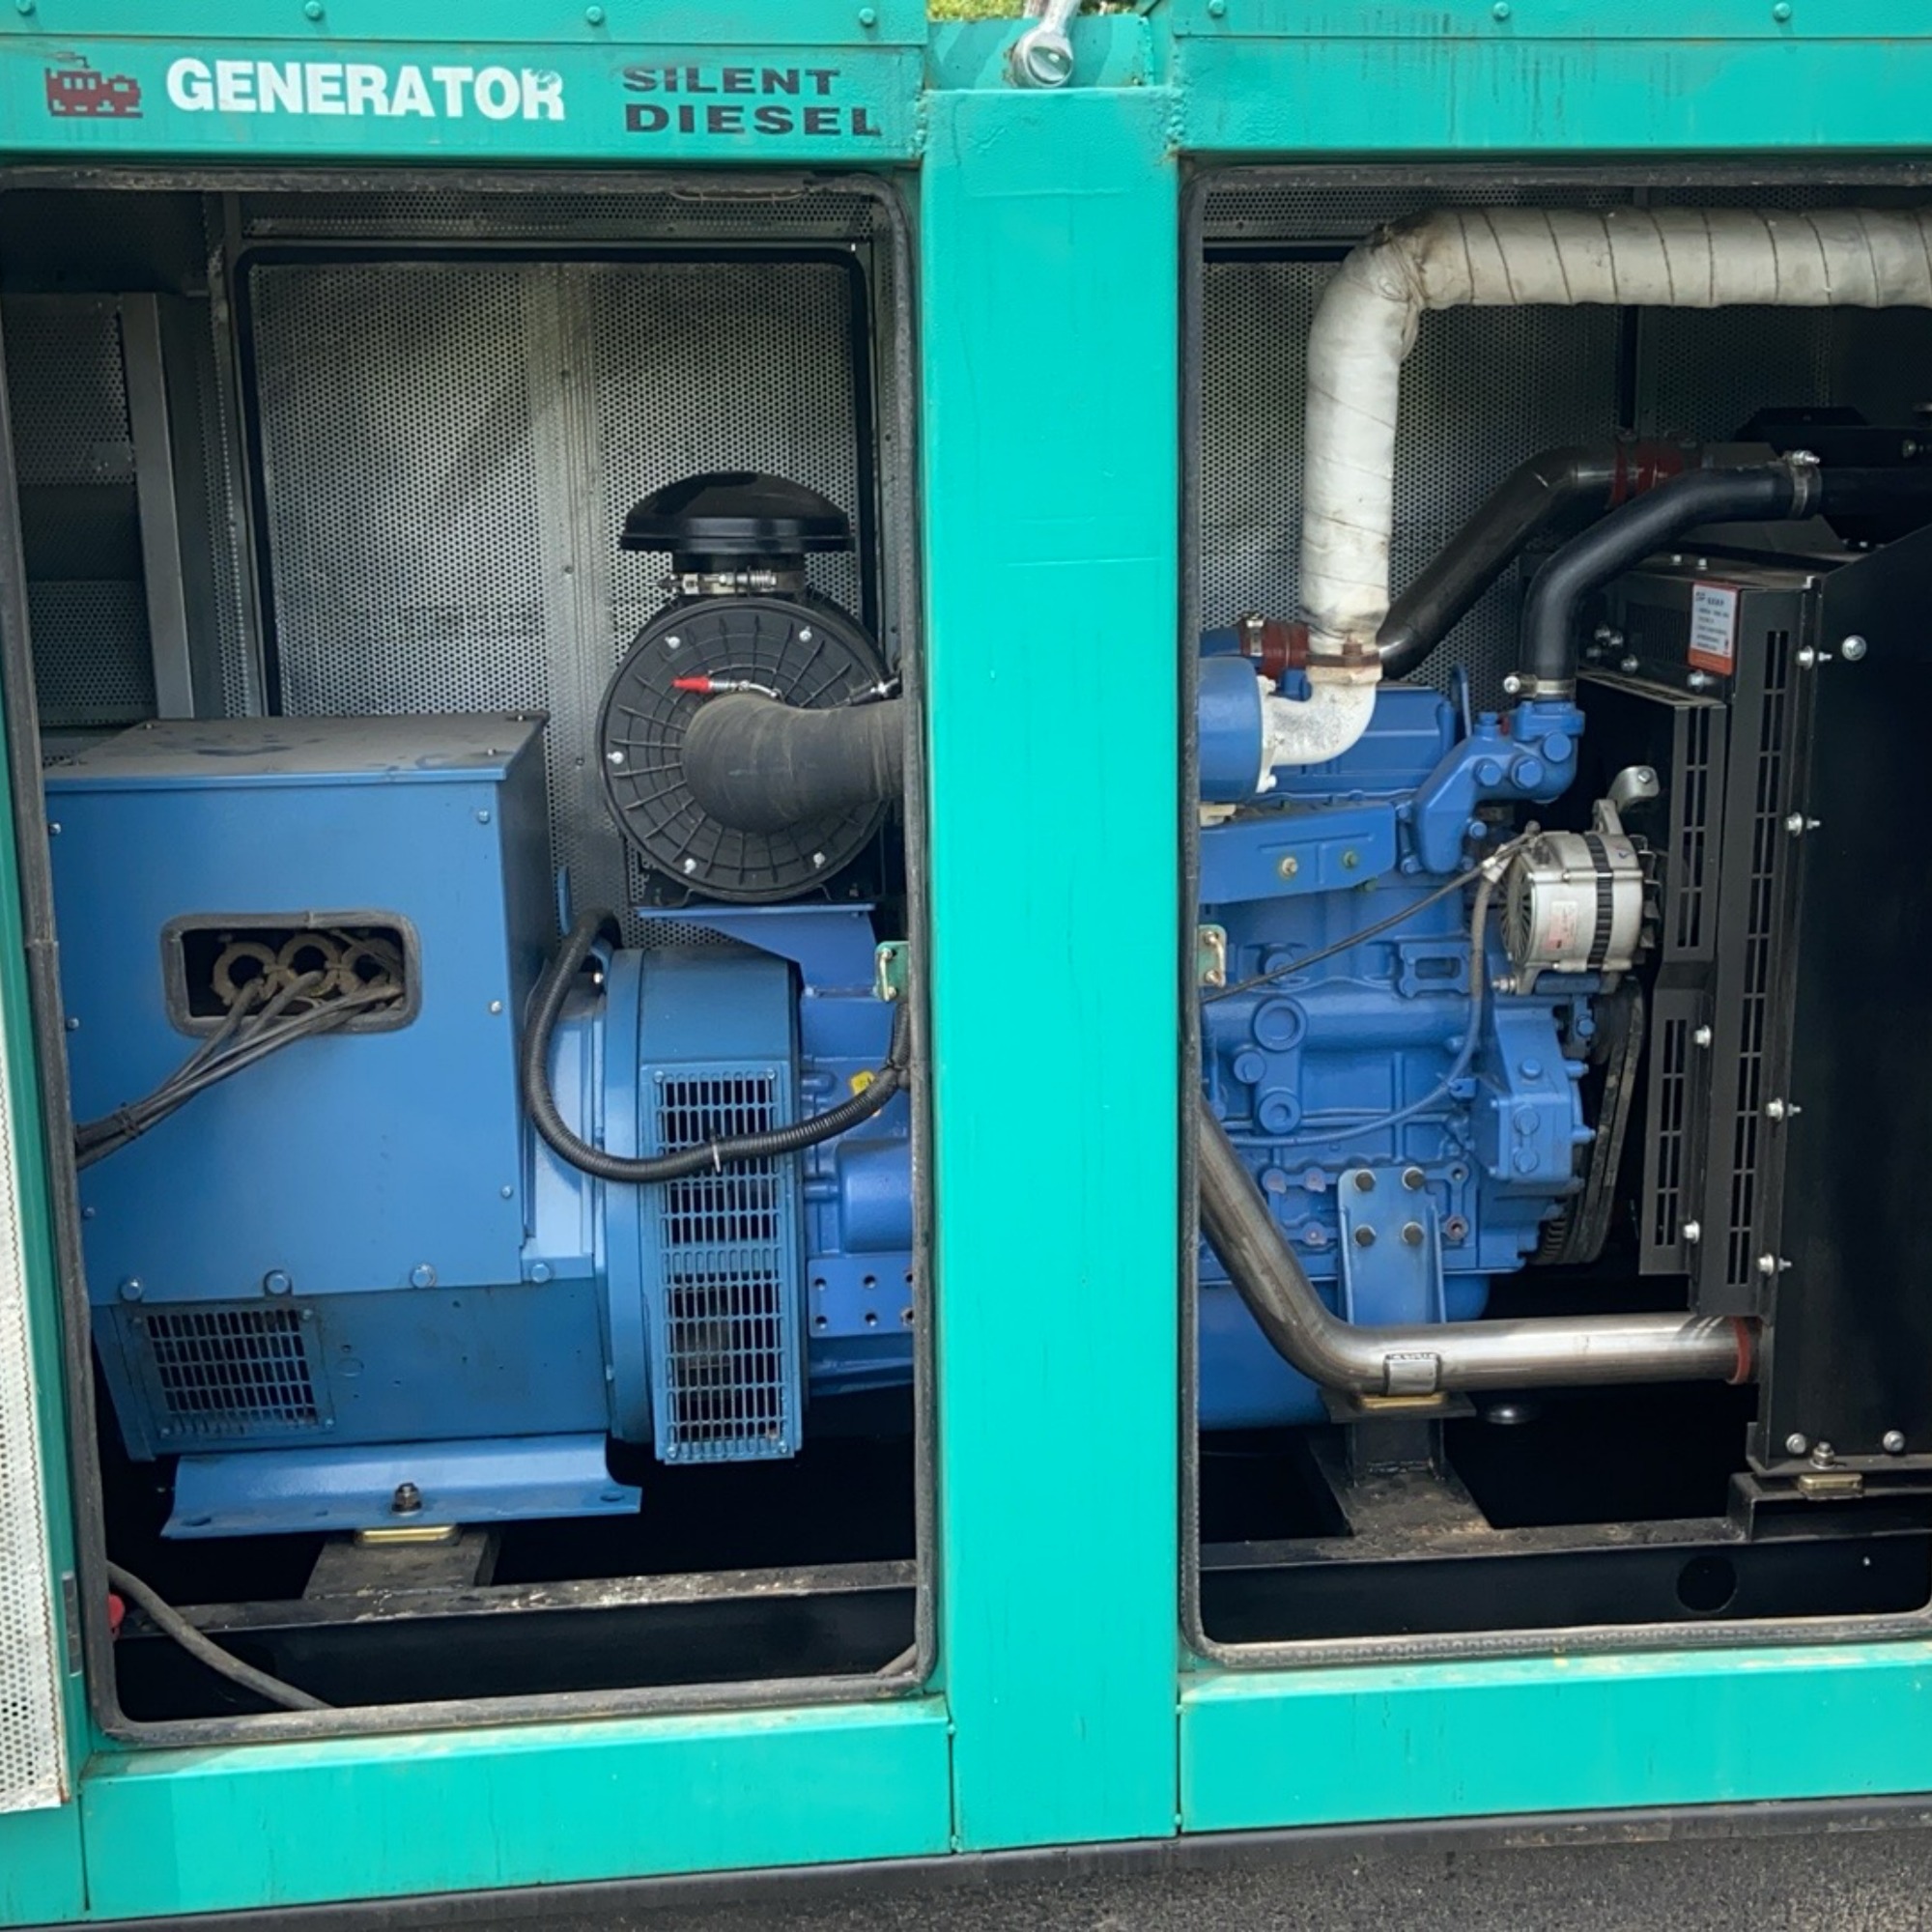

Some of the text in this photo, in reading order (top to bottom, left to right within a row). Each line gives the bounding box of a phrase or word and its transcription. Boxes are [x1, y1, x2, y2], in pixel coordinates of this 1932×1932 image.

[166, 58, 565, 122] GENERATOR
[623, 67, 840, 96] SILENT
[626, 103, 882, 137] DIESEL
